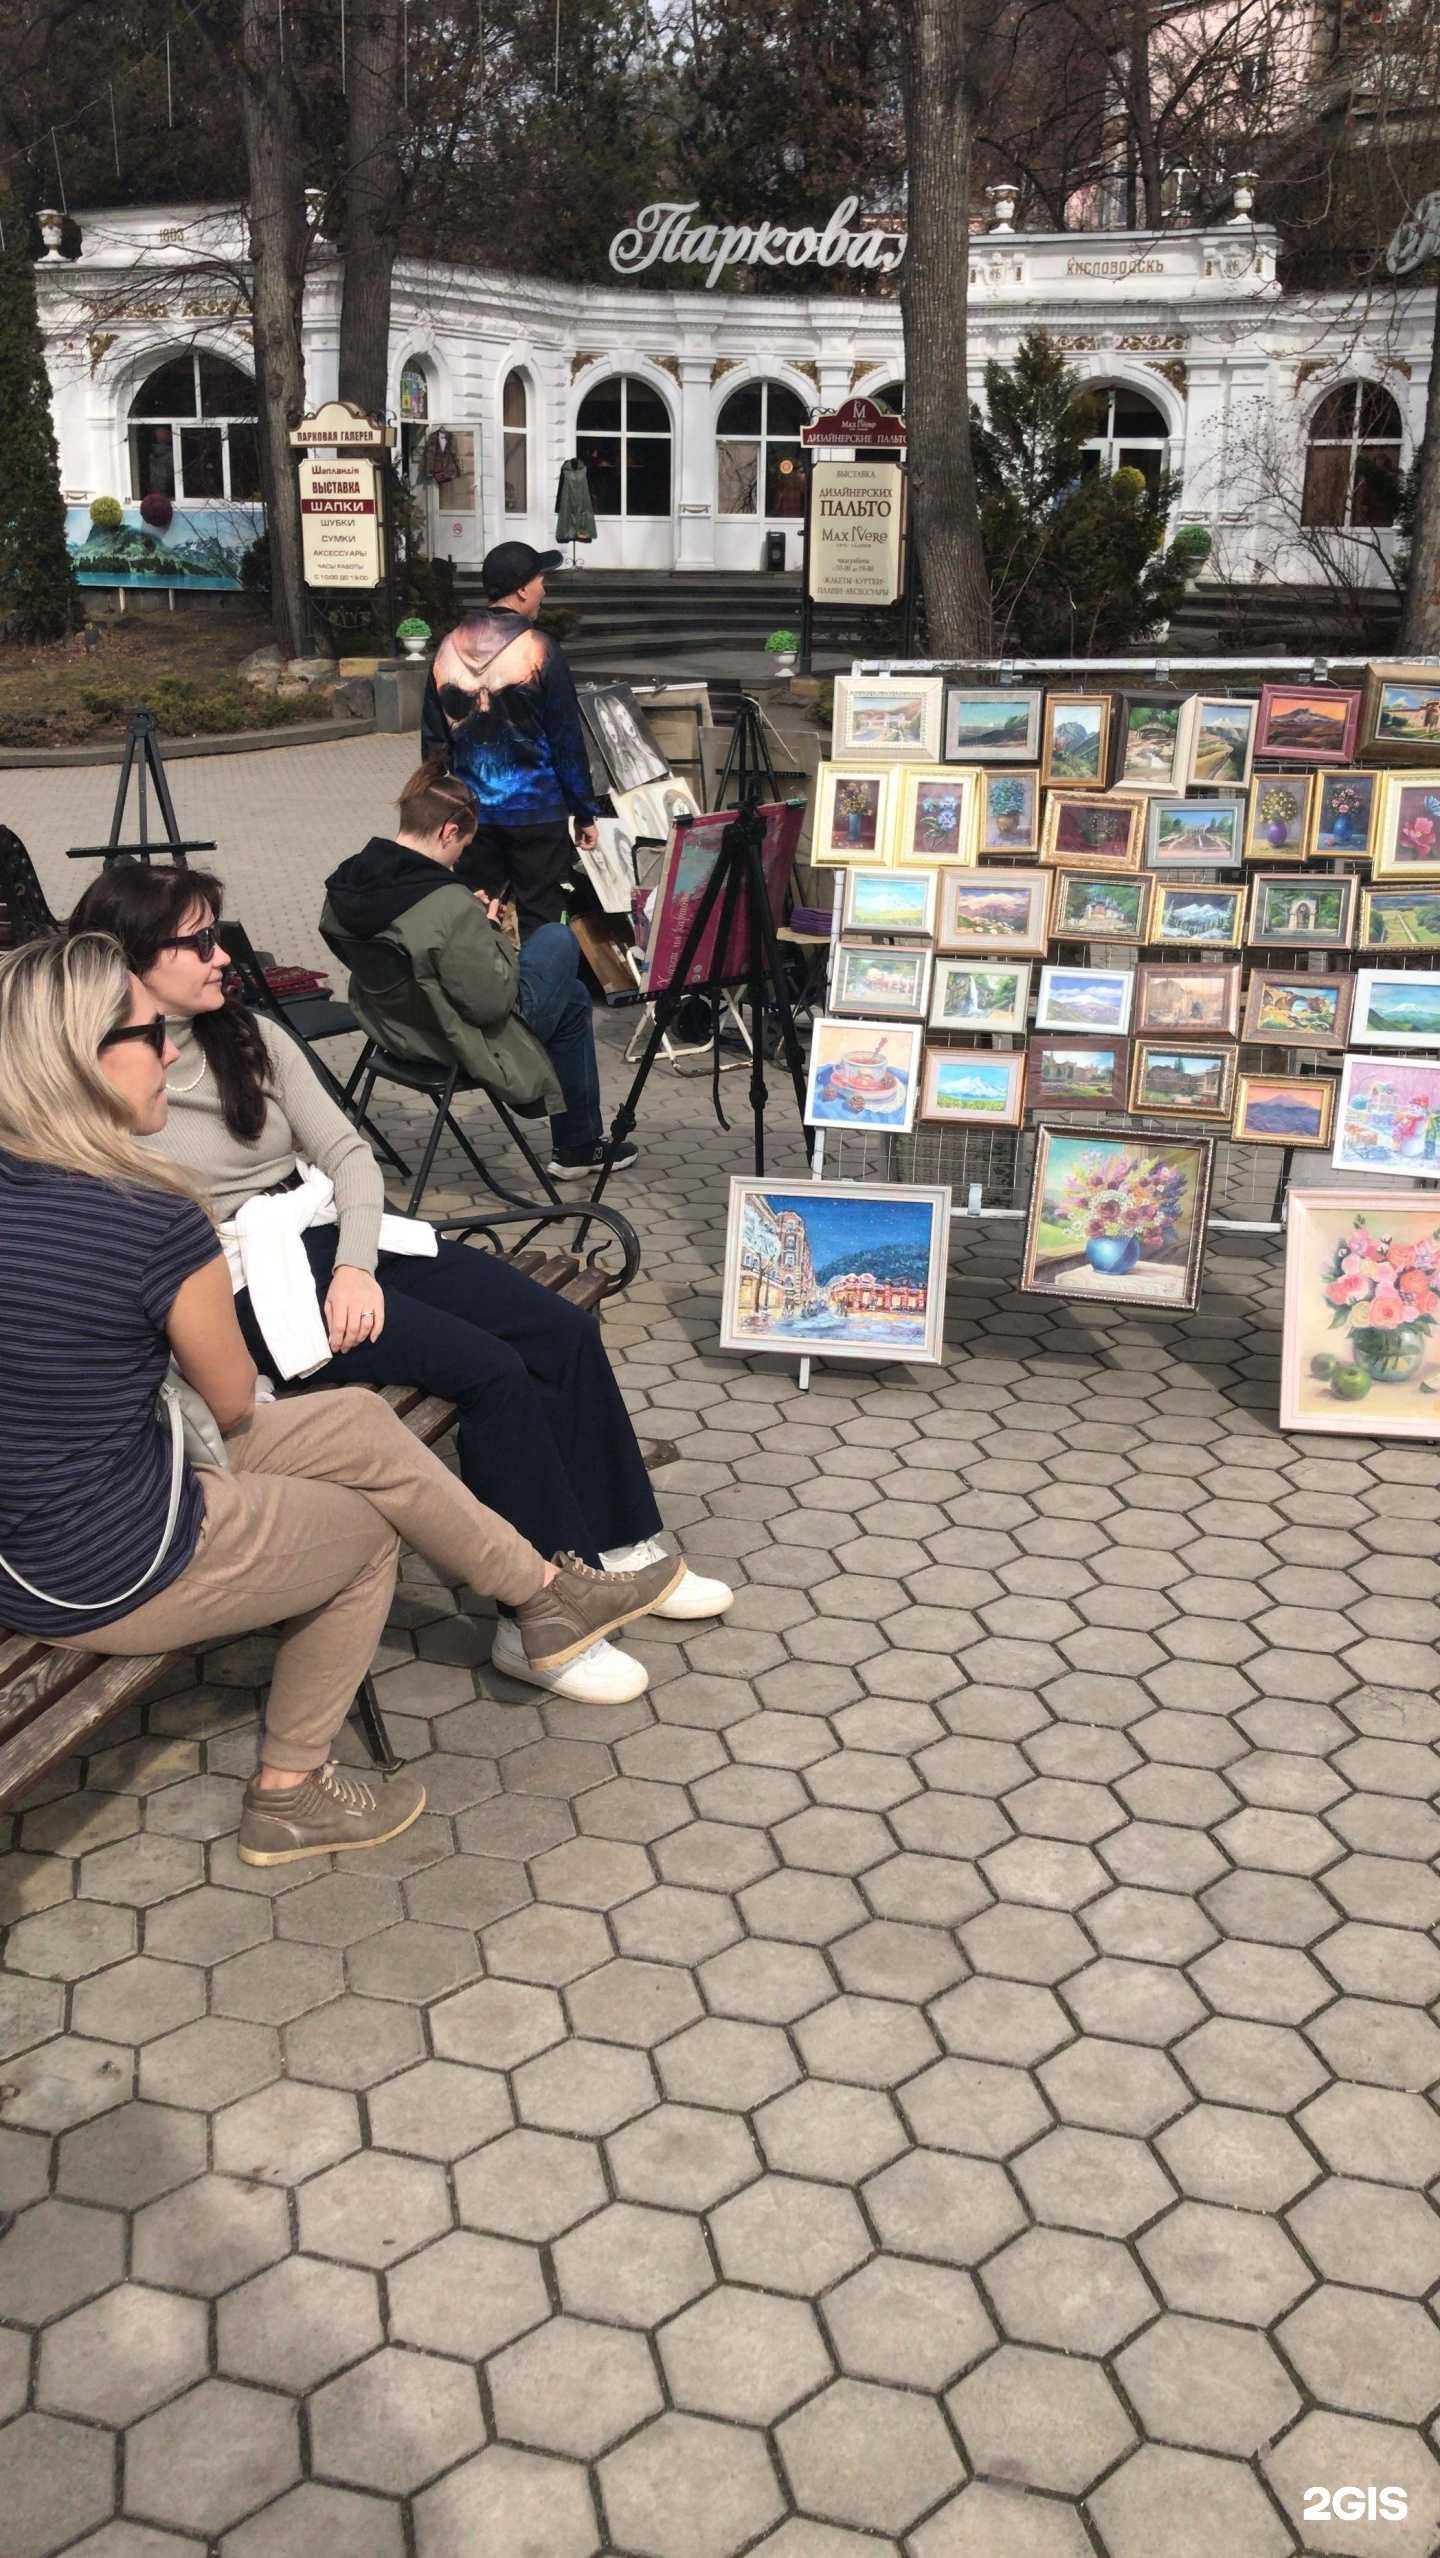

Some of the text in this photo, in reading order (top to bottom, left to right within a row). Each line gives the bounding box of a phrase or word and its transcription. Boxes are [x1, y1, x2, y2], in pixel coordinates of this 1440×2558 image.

[297, 431, 374, 441] ПАРКОВАЯ ГАЛЕРЕЯ
[807, 433, 873, 444] ДИЗАЙНЕРСКИЕ
[312, 481, 360, 494] ВЫСТАВКА
[819, 487, 893, 499] ДИЗАЙНЕРСКИХ
[310, 501, 364, 512] ШАПКИ
[820, 500, 892, 518] ПАЛЬТО
[320, 519, 356, 527] ШУБКИ
[321, 535, 357, 543] СУМКИ
[313, 549, 368, 557] АКСЕССУАРЫ
